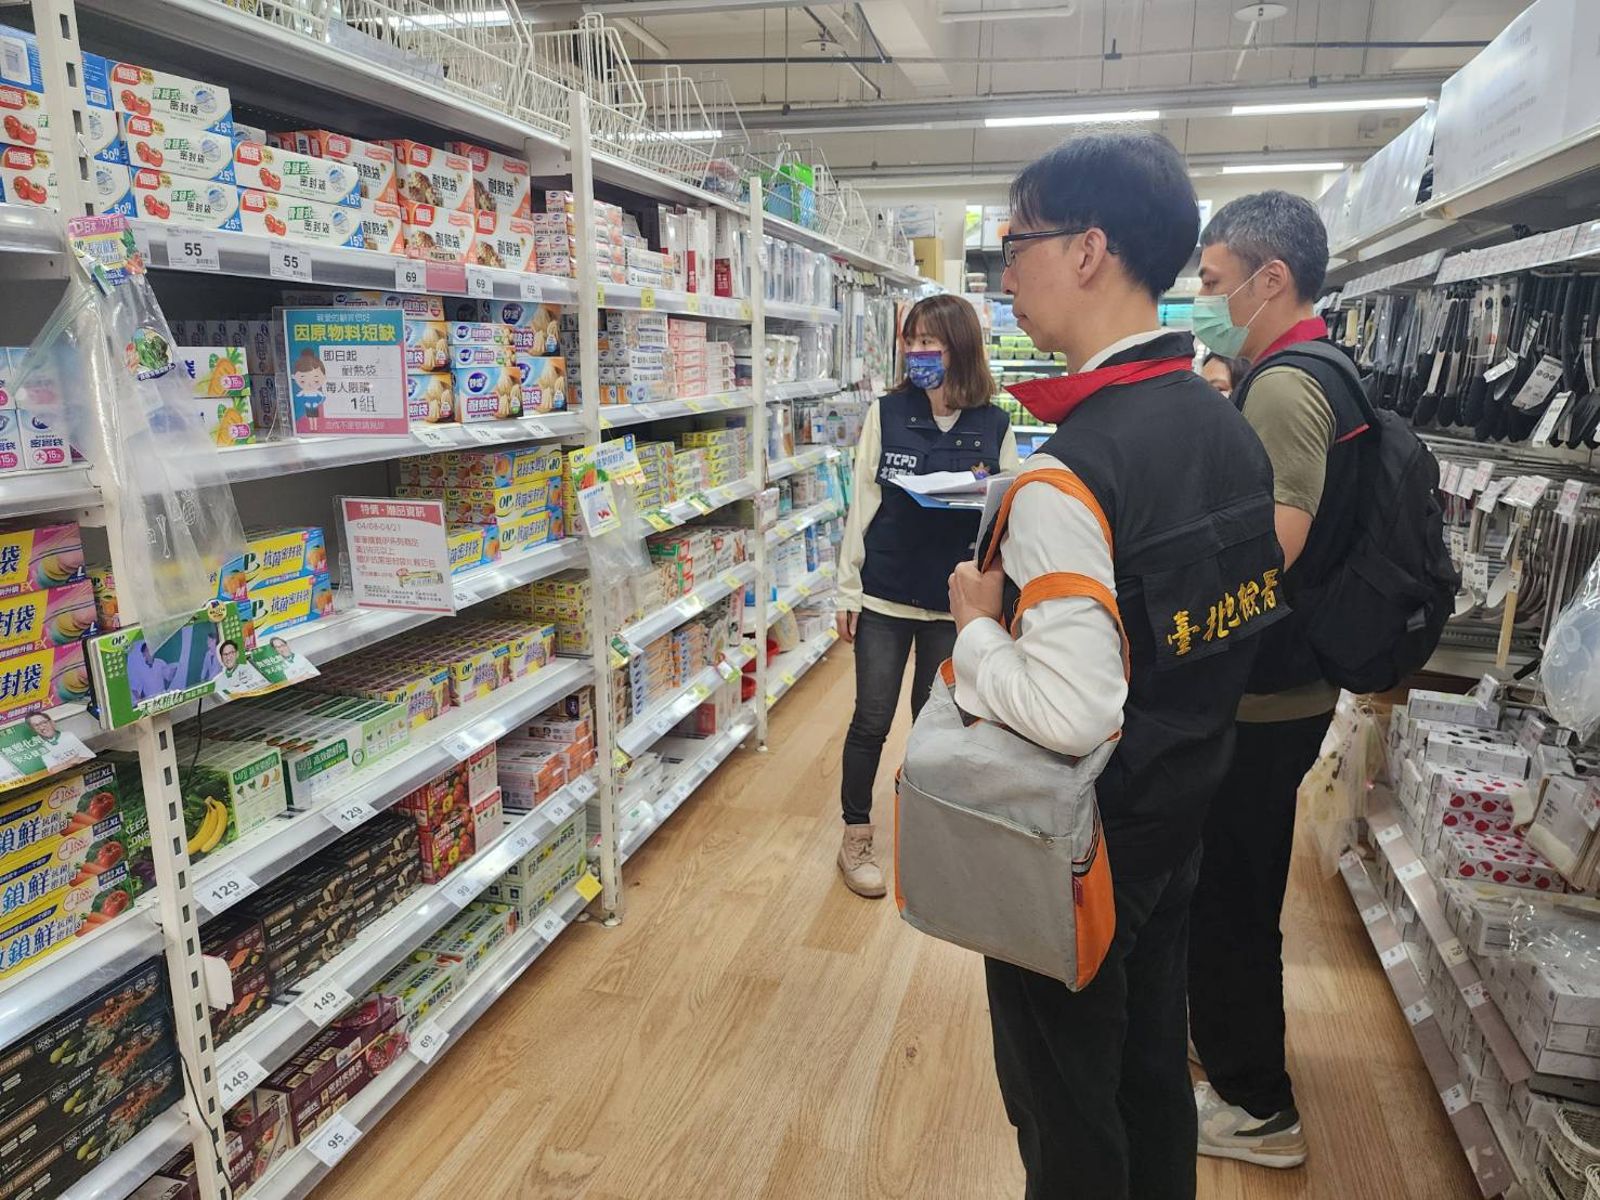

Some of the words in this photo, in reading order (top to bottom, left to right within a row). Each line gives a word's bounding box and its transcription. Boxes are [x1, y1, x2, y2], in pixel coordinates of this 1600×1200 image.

[184, 242, 203, 257] 55
[283, 254, 299, 269] 55
[405, 271, 417, 283] 69
[323, 349, 358, 362] 即日起
[350, 395, 377, 413] 1組
[884, 452, 918, 468] TCPD
[498, 494, 513, 510] OP
[502, 528, 516, 543] OP
[111, 635, 128, 646] OP
[340, 806, 364, 822] 129
[211, 879, 241, 901] 129
[312, 990, 337, 1012] 149
[419, 1033, 434, 1049] 69
[222, 1069, 250, 1094] 149
[327, 1132, 345, 1150] 95
